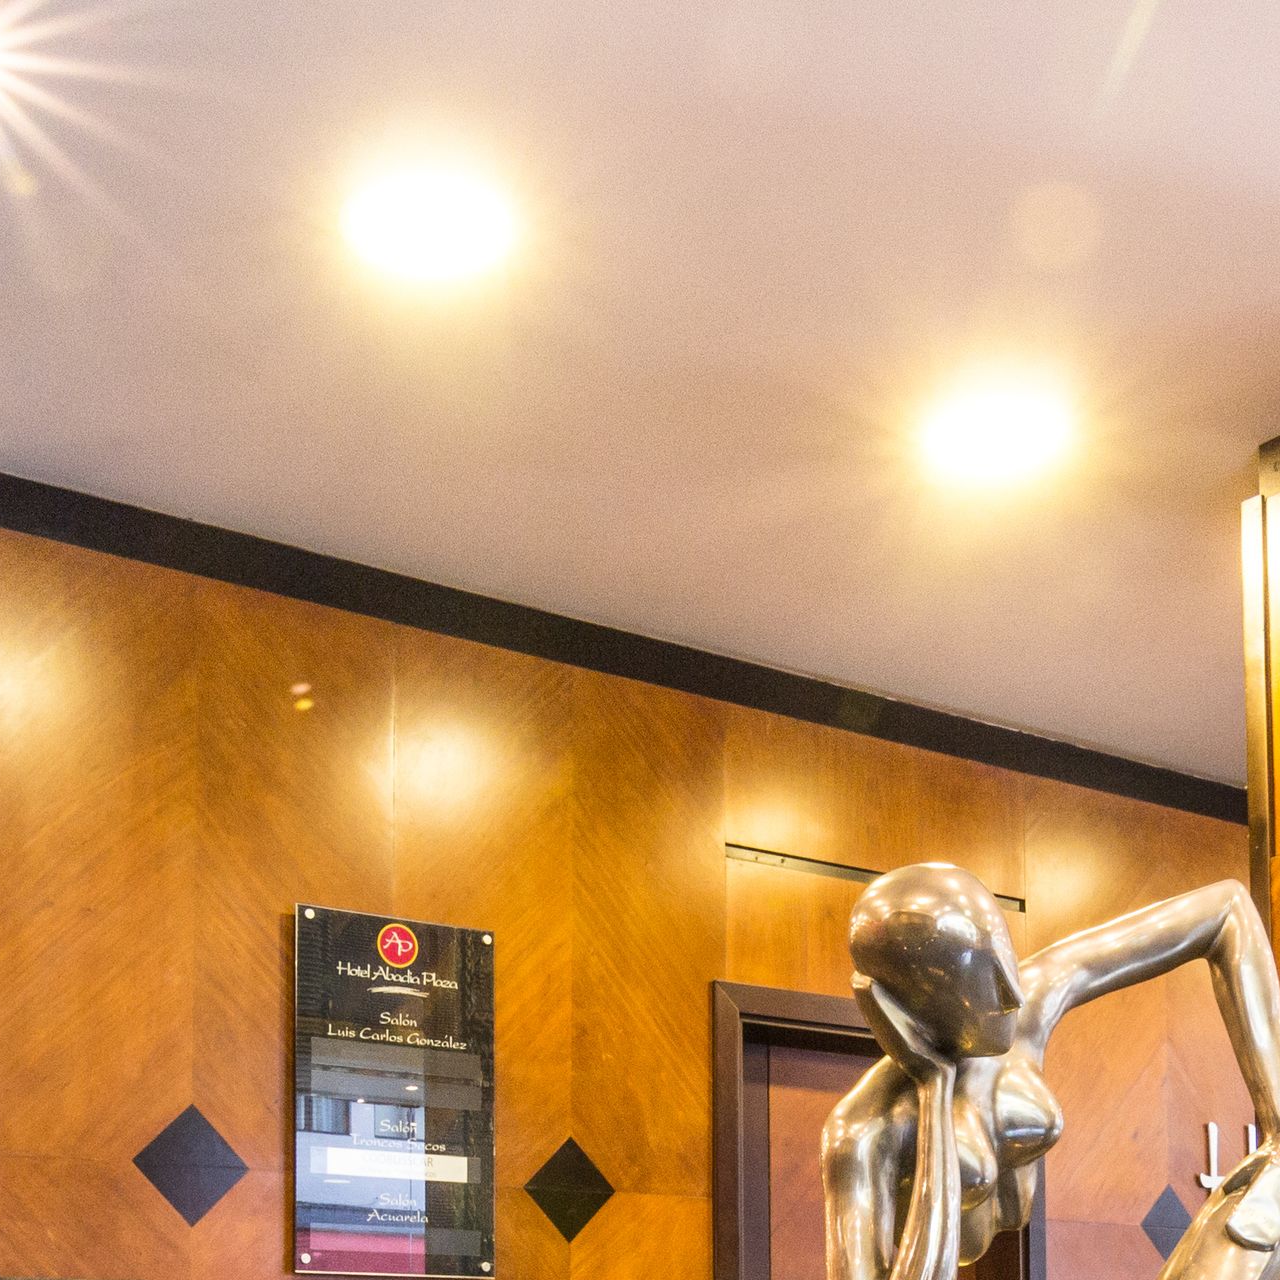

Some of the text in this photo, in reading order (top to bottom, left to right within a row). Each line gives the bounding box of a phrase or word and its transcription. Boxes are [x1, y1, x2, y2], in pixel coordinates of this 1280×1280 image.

[336, 961, 459, 990] Hotel Abadia Plaza
[379, 1012, 418, 1028] Salón
[327, 1023, 467, 1050] Luis Carlos González
[380, 1119, 417, 1133] Salón
[351, 1134, 402, 1149] Troncos
[380, 1193, 417, 1207] Salón
[366, 1209, 429, 1224] Acuarela
